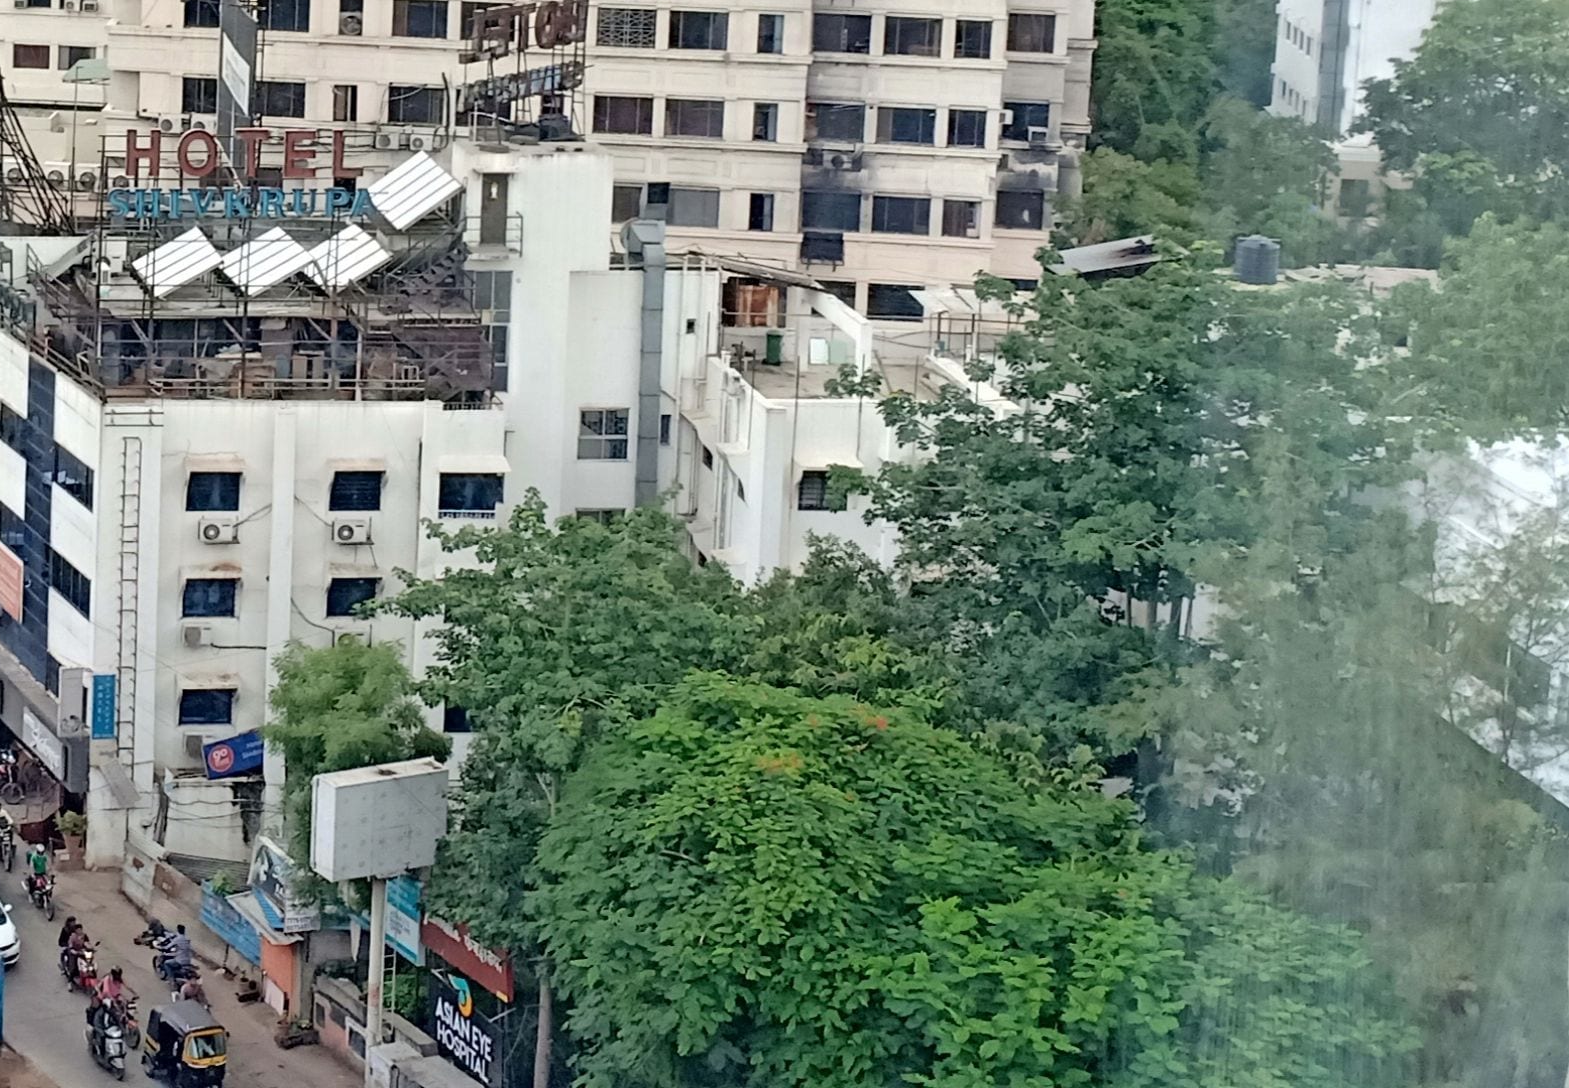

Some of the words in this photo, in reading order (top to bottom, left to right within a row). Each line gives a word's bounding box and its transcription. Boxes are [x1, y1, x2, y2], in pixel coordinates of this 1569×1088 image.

[125, 128, 364, 178] HOTEL
[107, 188, 379, 220] SHIVKRUPA
[435, 996, 471, 1043] ASIAN
[472, 1025, 492, 1062] EYE
[437, 1019, 490, 1084] HOSPITAL
